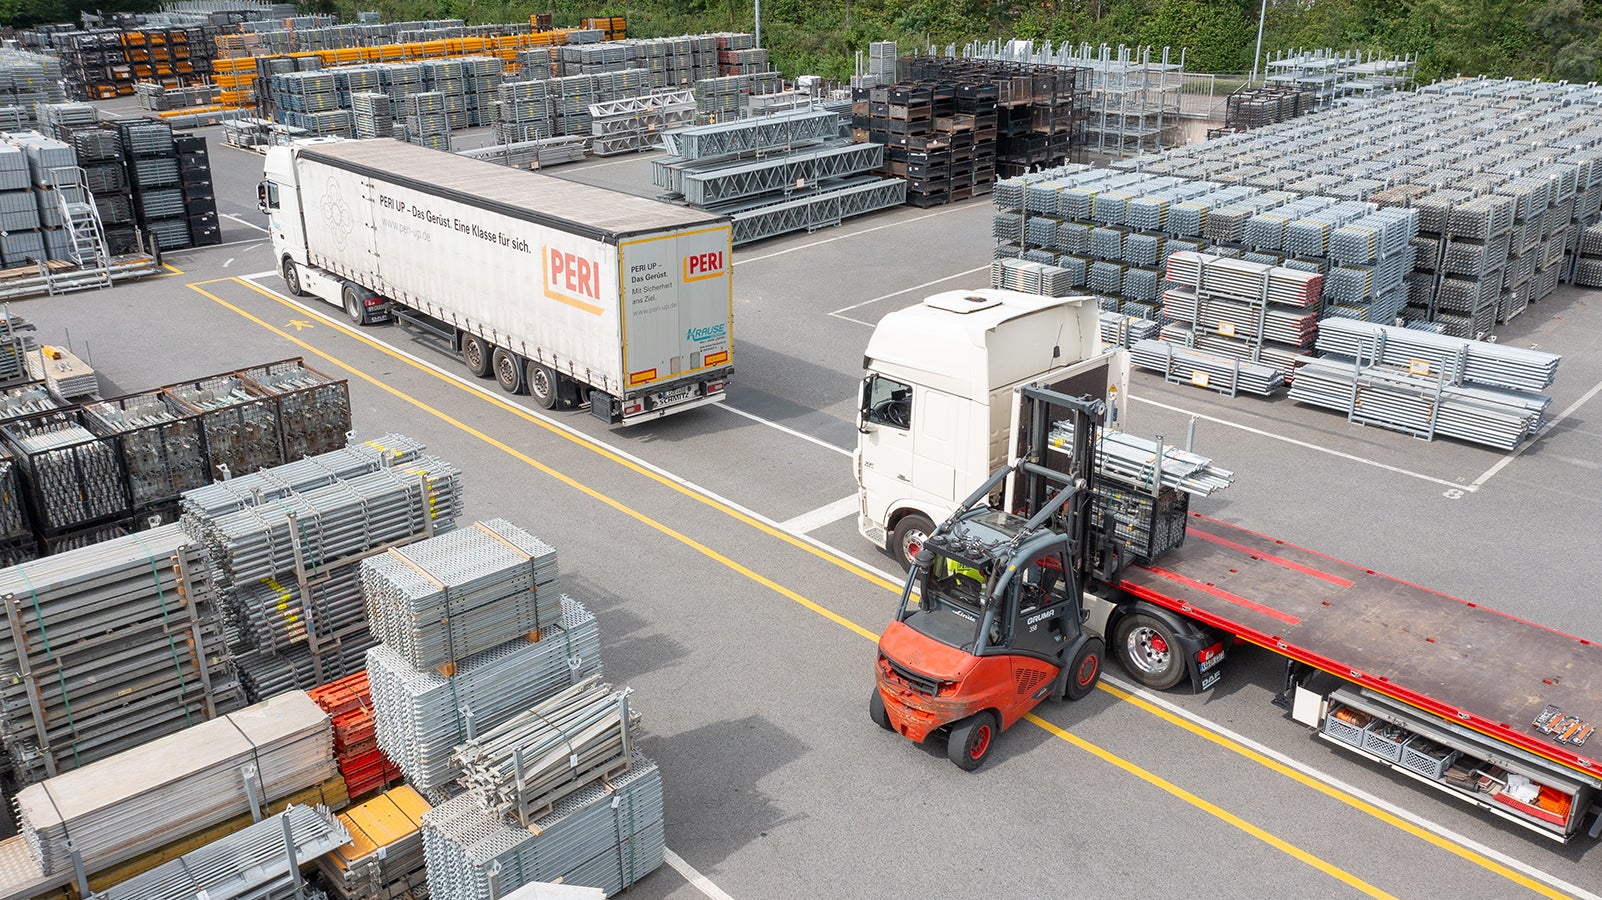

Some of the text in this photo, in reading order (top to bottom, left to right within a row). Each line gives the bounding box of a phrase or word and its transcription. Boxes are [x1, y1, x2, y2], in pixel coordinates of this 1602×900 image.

[379, 195, 395, 210] PERI
[395, 200, 406, 213] UP
[412, 205, 425, 220] Das
[426, 210, 453, 229] Gerüst.
[454, 219, 471, 235] Eine
[471, 224, 497, 243] Klasse
[498, 232, 510, 247] für
[512, 237, 532, 254] sich.
[630, 264, 646, 273] PERI
[647, 262, 657, 271] UP
[689, 250, 723, 275] PERI
[550, 247, 601, 300] PERI
[631, 275, 644, 284] Das
[686, 323, 727, 342] KRAUSE
[659, 392, 690, 405] SCHMITZ
[1026, 608, 1056, 626] GRUMA
[1201, 670, 1221, 688] DAF
